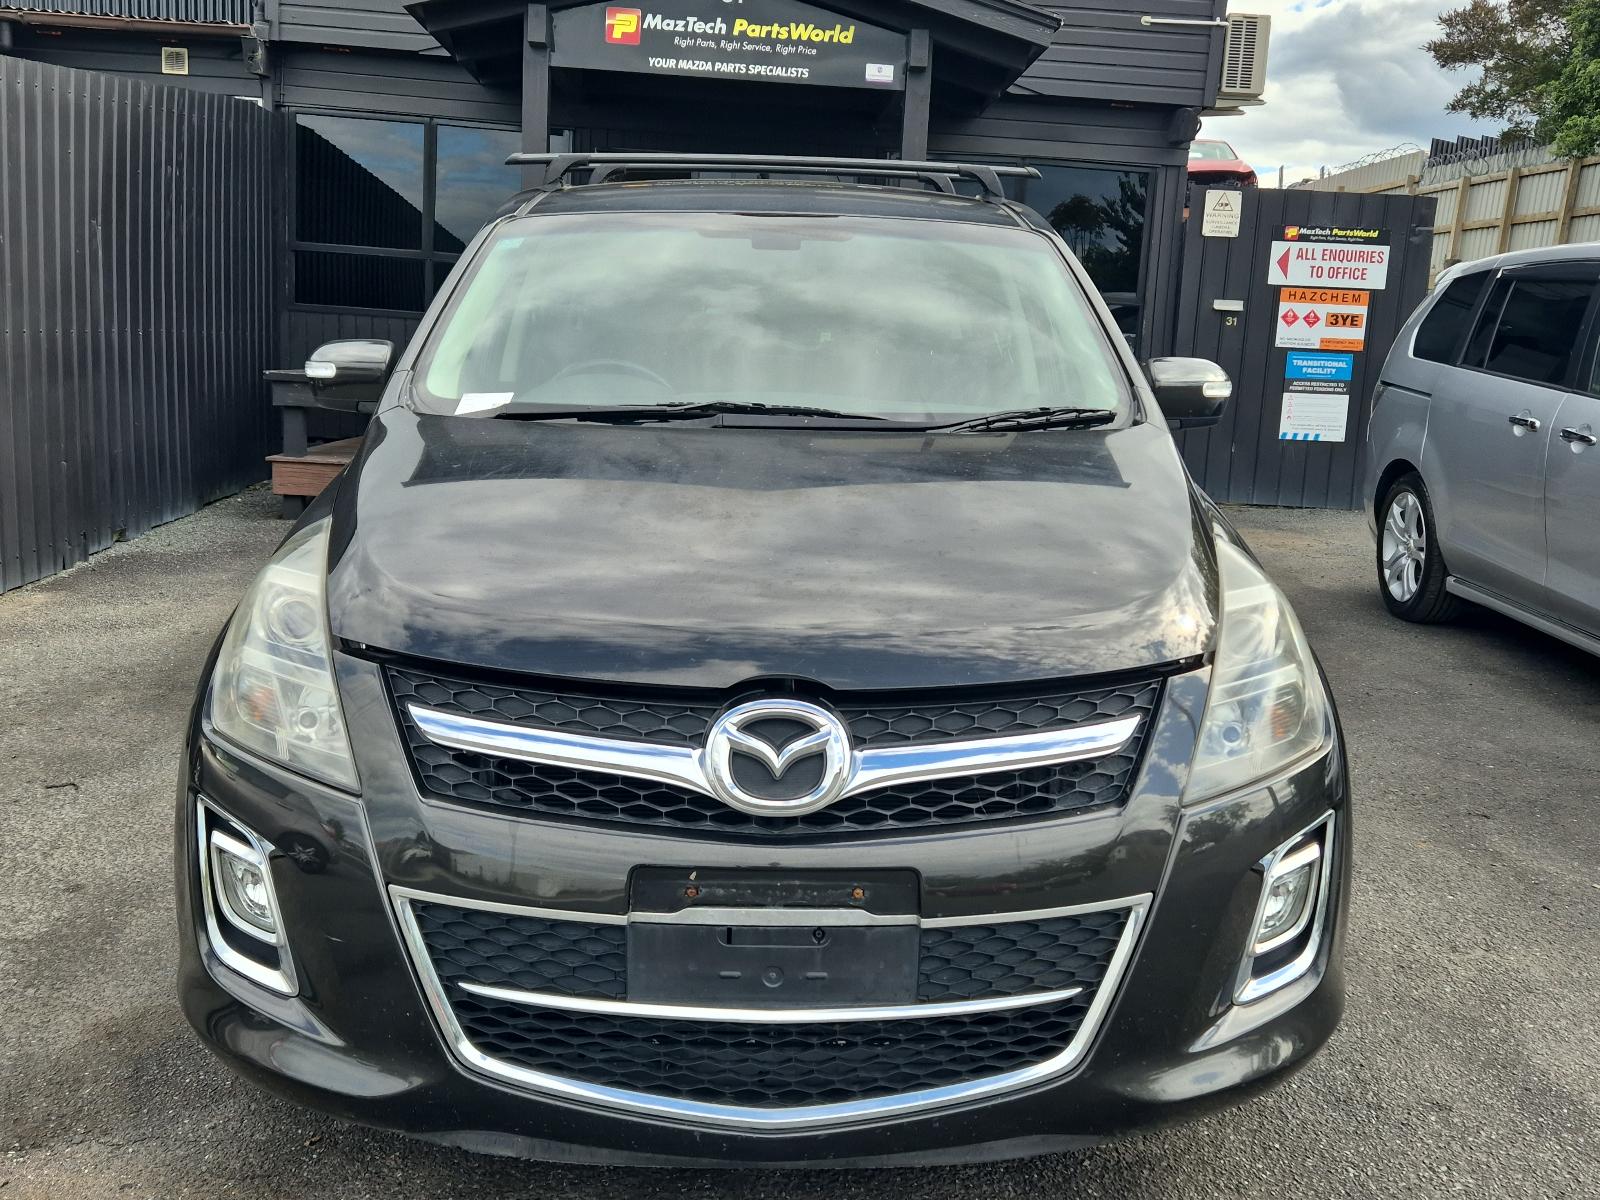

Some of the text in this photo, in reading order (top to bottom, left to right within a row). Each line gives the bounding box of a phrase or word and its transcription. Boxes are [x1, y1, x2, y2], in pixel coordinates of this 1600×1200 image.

[643, 13, 855, 44] MazTech PartsWorld
[674, 36, 817, 55] Right Parts, Right Service, Right Price
[649, 57, 809, 78] YOUR MAZDA PARTS SPECIALISTS
[1299, 227, 1379, 238] MazTech PartsWorld
[1296, 247, 1385, 264] ALL ENQUIRIES
[1310, 265, 1368, 281] TO OFFICE
[1288, 290, 1362, 303] HAZCHEM
[1225, 316, 1238, 326] 31
[1329, 314, 1360, 327] 3YE
[1293, 360, 1348, 368] TRANSITIONAL
[1302, 367, 1337, 375] FACILITY
